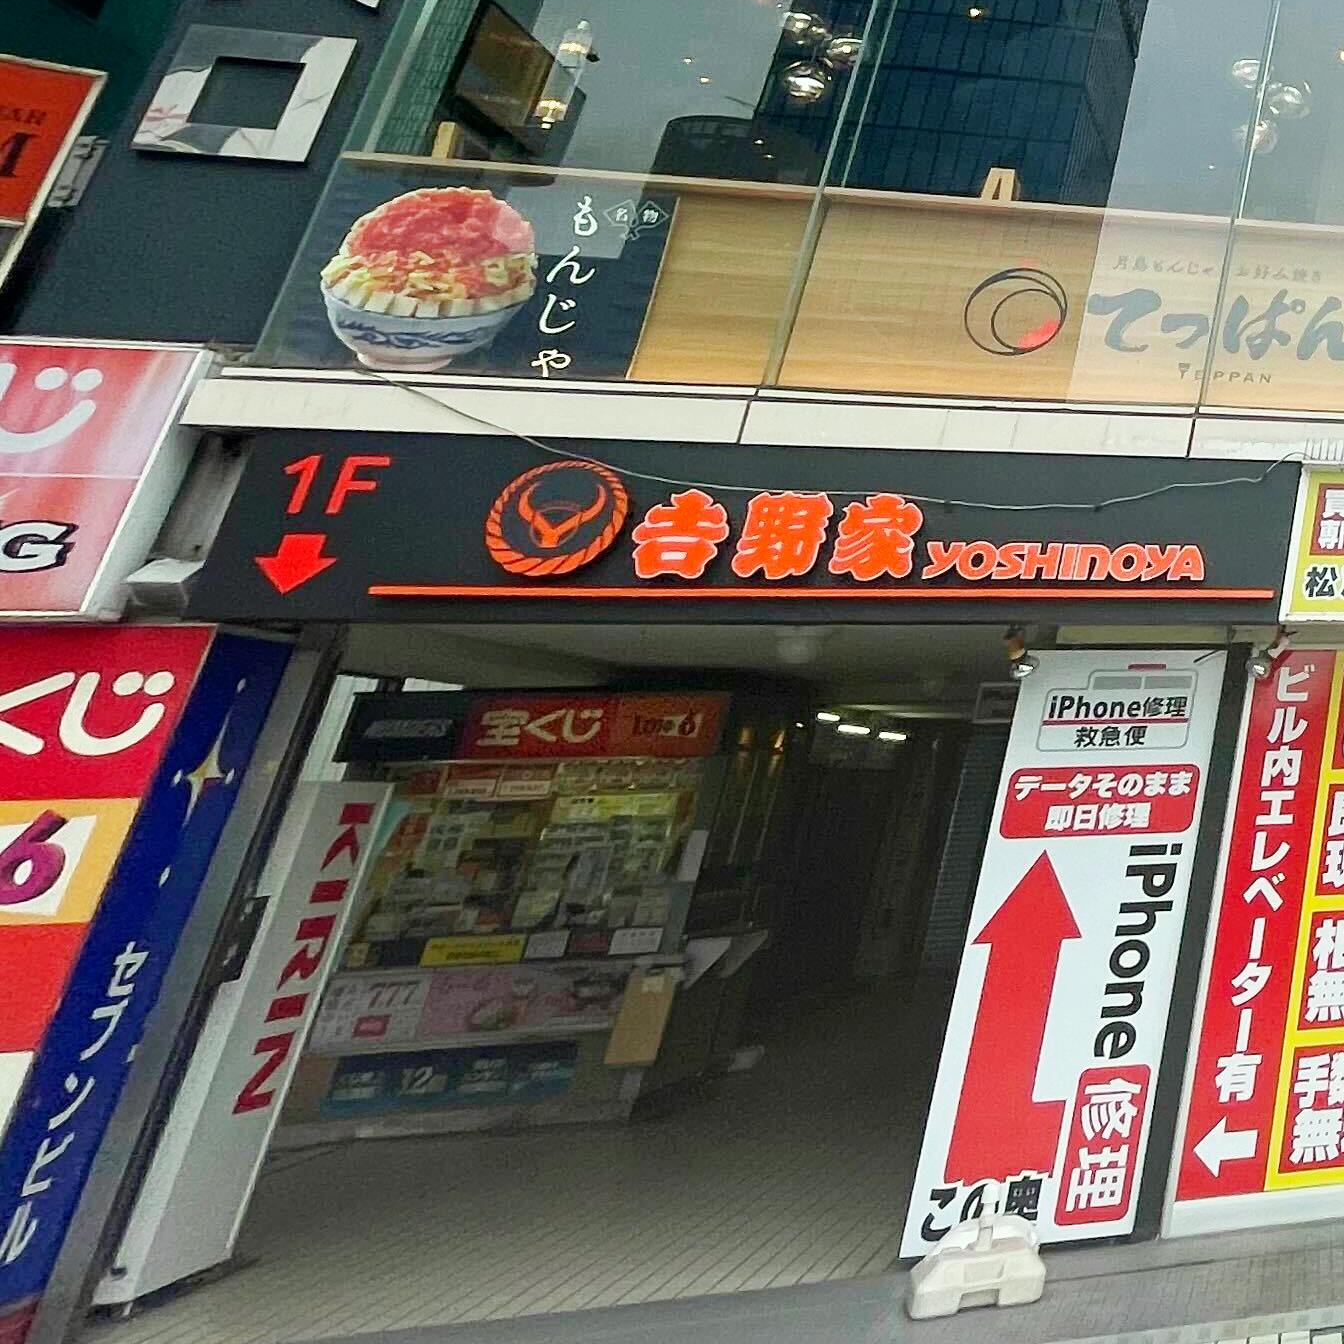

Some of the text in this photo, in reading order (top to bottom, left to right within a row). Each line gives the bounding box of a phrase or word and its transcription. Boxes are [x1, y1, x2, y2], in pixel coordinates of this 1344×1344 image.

[531, 195, 599, 378] もんじゃ
[1178, 362, 1272, 384] TEPPAN
[283, 454, 391, 515] 1F
[631, 488, 924, 581] 吉野家
[1048, 694, 1188, 721] iPhone修理
[1073, 724, 1147, 748] 救急便
[1013, 769, 1194, 800] データそのまま
[1043, 803, 1152, 832] 即日修理
[1214, 664, 1317, 1105] ビル内エレベーター有
[231, 802, 377, 1116] KIRIN
[1092, 842, 1183, 1062] iPhone
[1065, 1075, 1142, 1214] 修理
